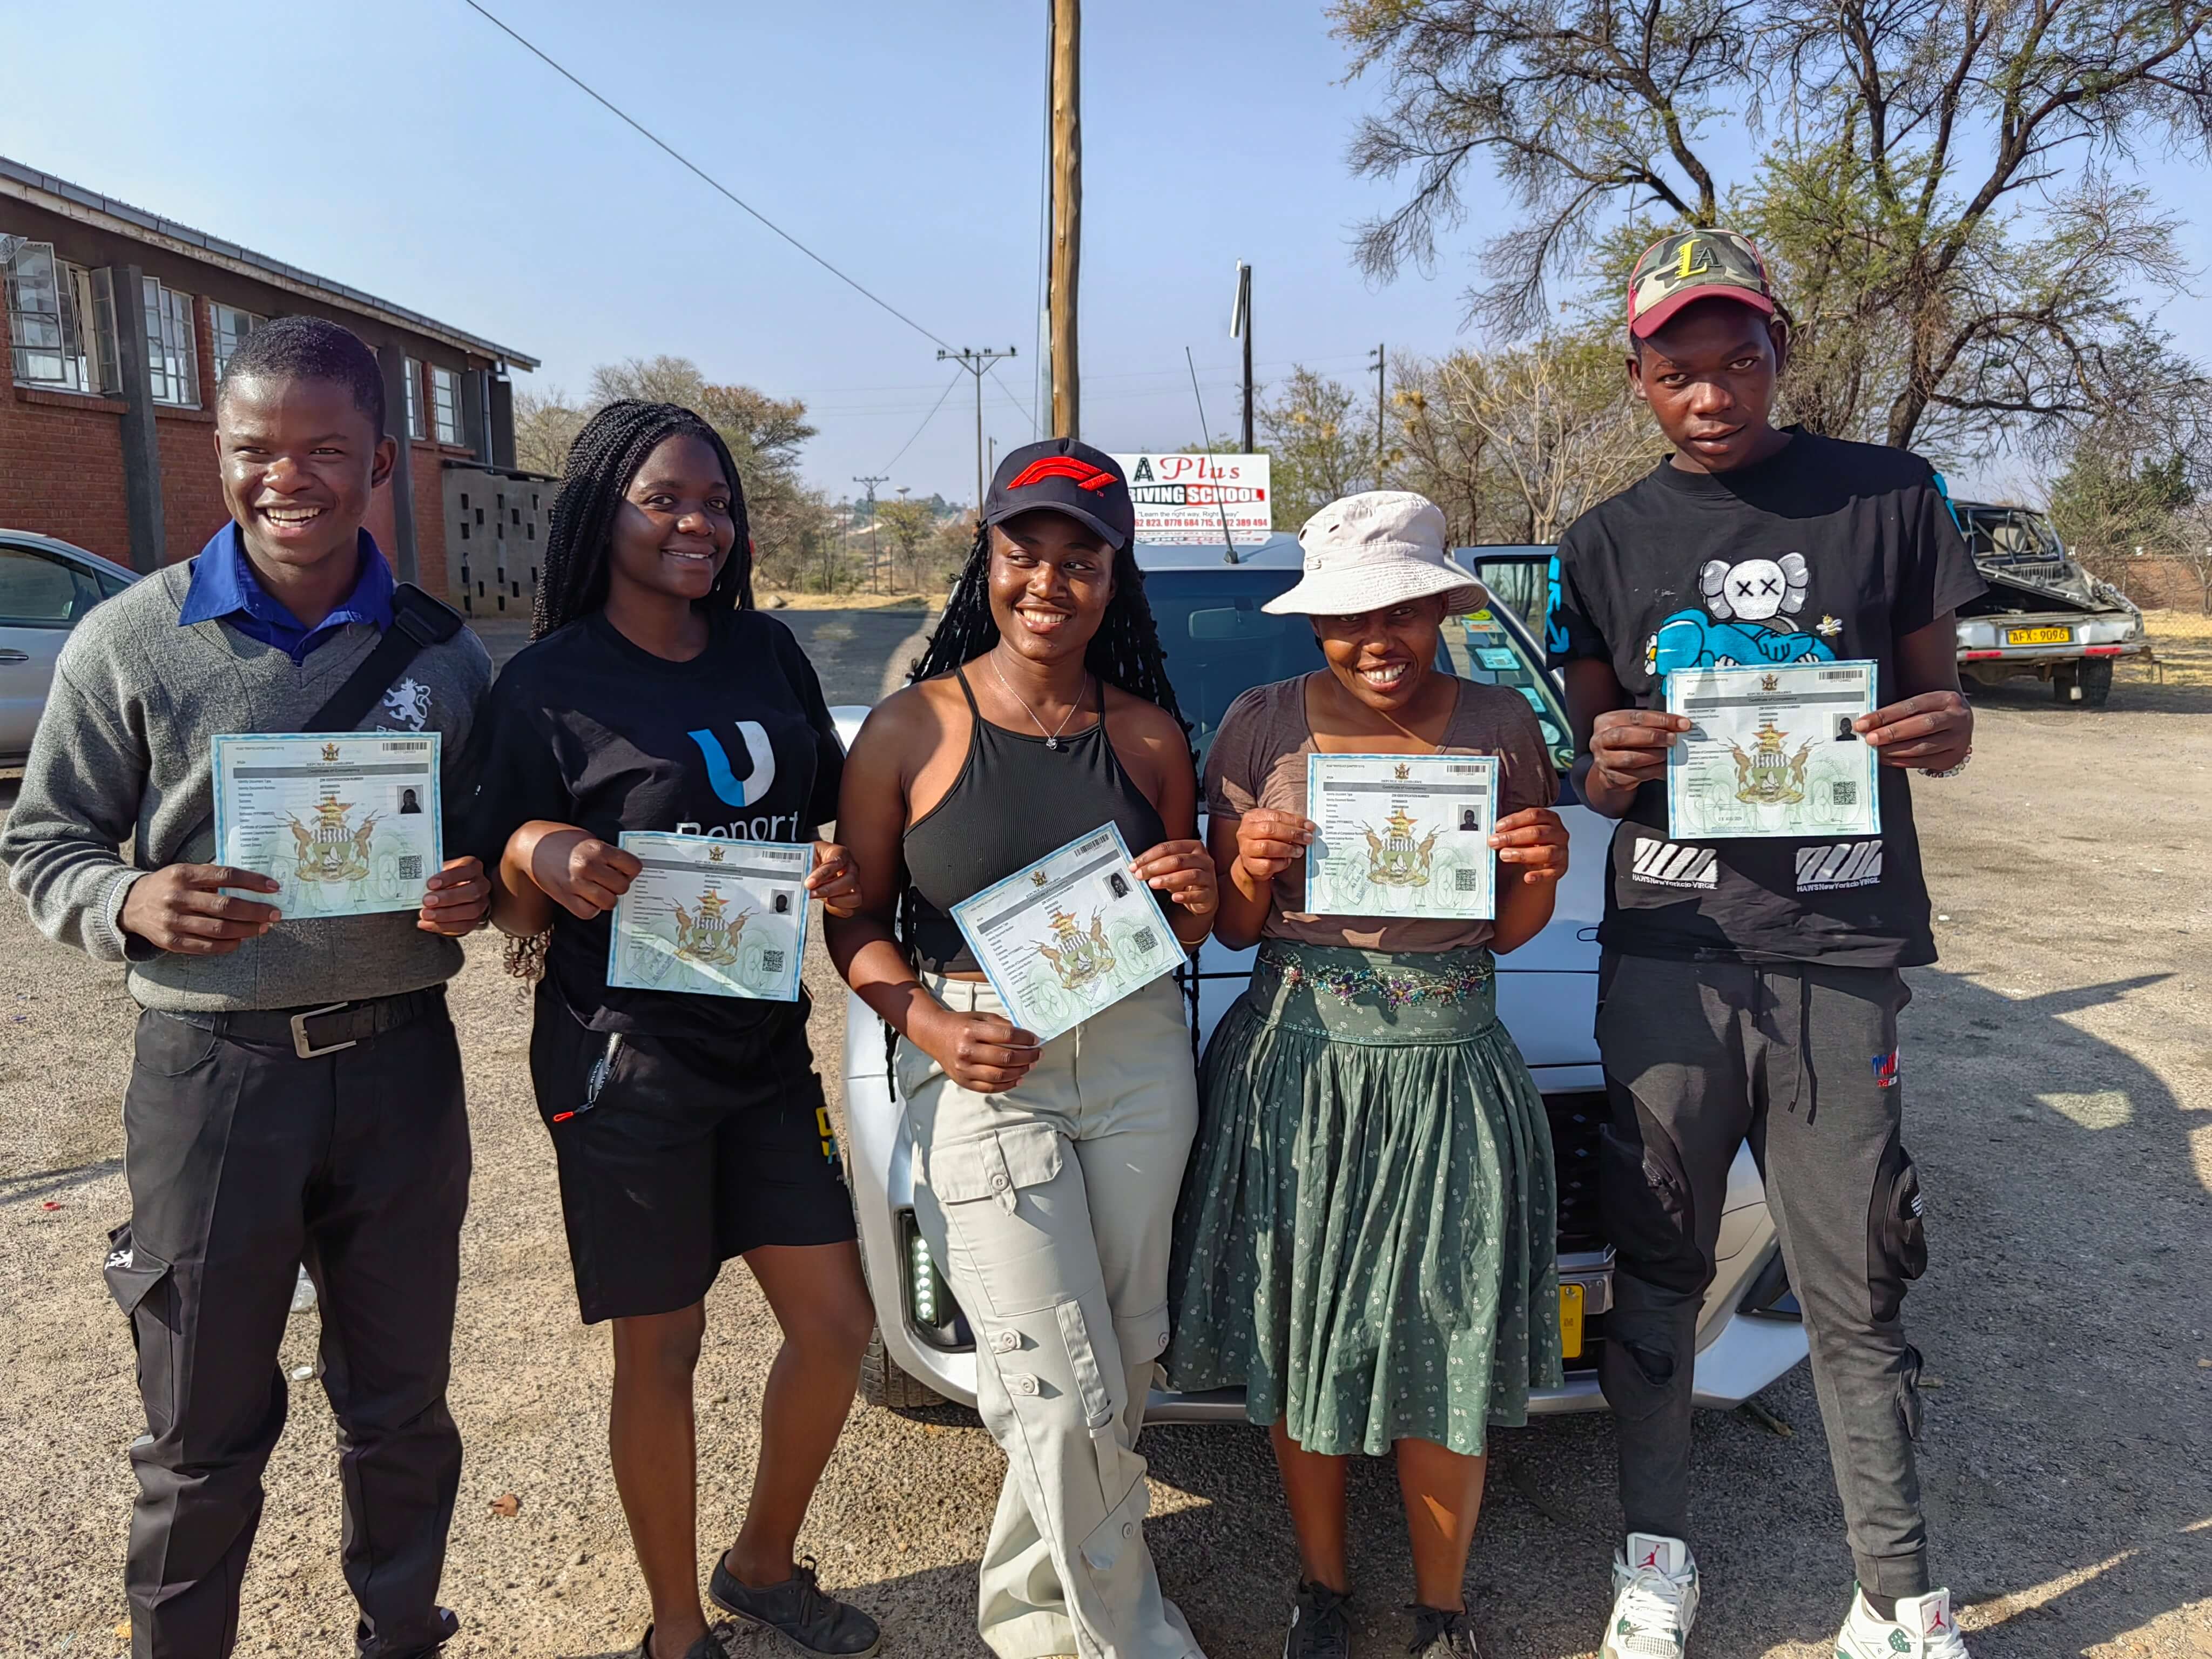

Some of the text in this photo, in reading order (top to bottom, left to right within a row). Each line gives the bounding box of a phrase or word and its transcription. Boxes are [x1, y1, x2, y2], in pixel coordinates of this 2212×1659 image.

[1134, 457, 1240, 482] A Plus
[1129, 486, 1261, 503] RIVING SCHOOL
[1184, 519, 1199, 527] 684
[1236, 518, 1251, 527] 389
[1253, 518, 1267, 527] 494
[2040, 629, 2065, 640] 9096
